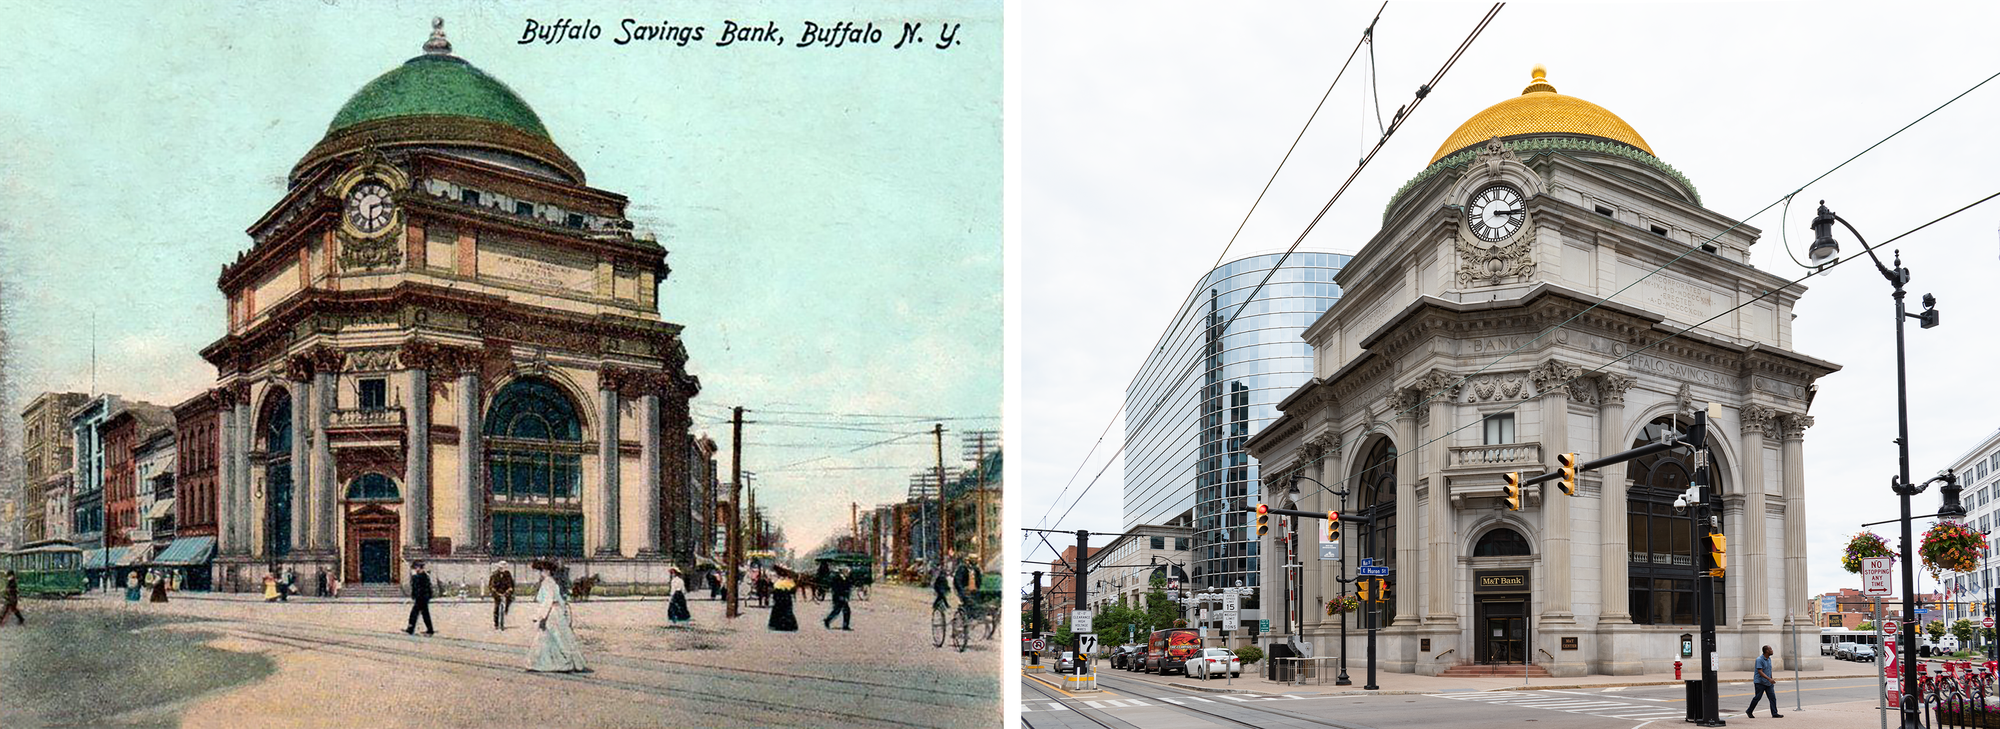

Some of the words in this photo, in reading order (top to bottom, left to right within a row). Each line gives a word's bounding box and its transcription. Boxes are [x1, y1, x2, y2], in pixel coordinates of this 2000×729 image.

[1473, 336, 1521, 352] BANK
[1669, 364, 1709, 382] SAVINGS
[1713, 374, 1740, 389] BANK
[1871, 560, 1882, 568] NO
[1482, 577, 1500, 585] M&T
